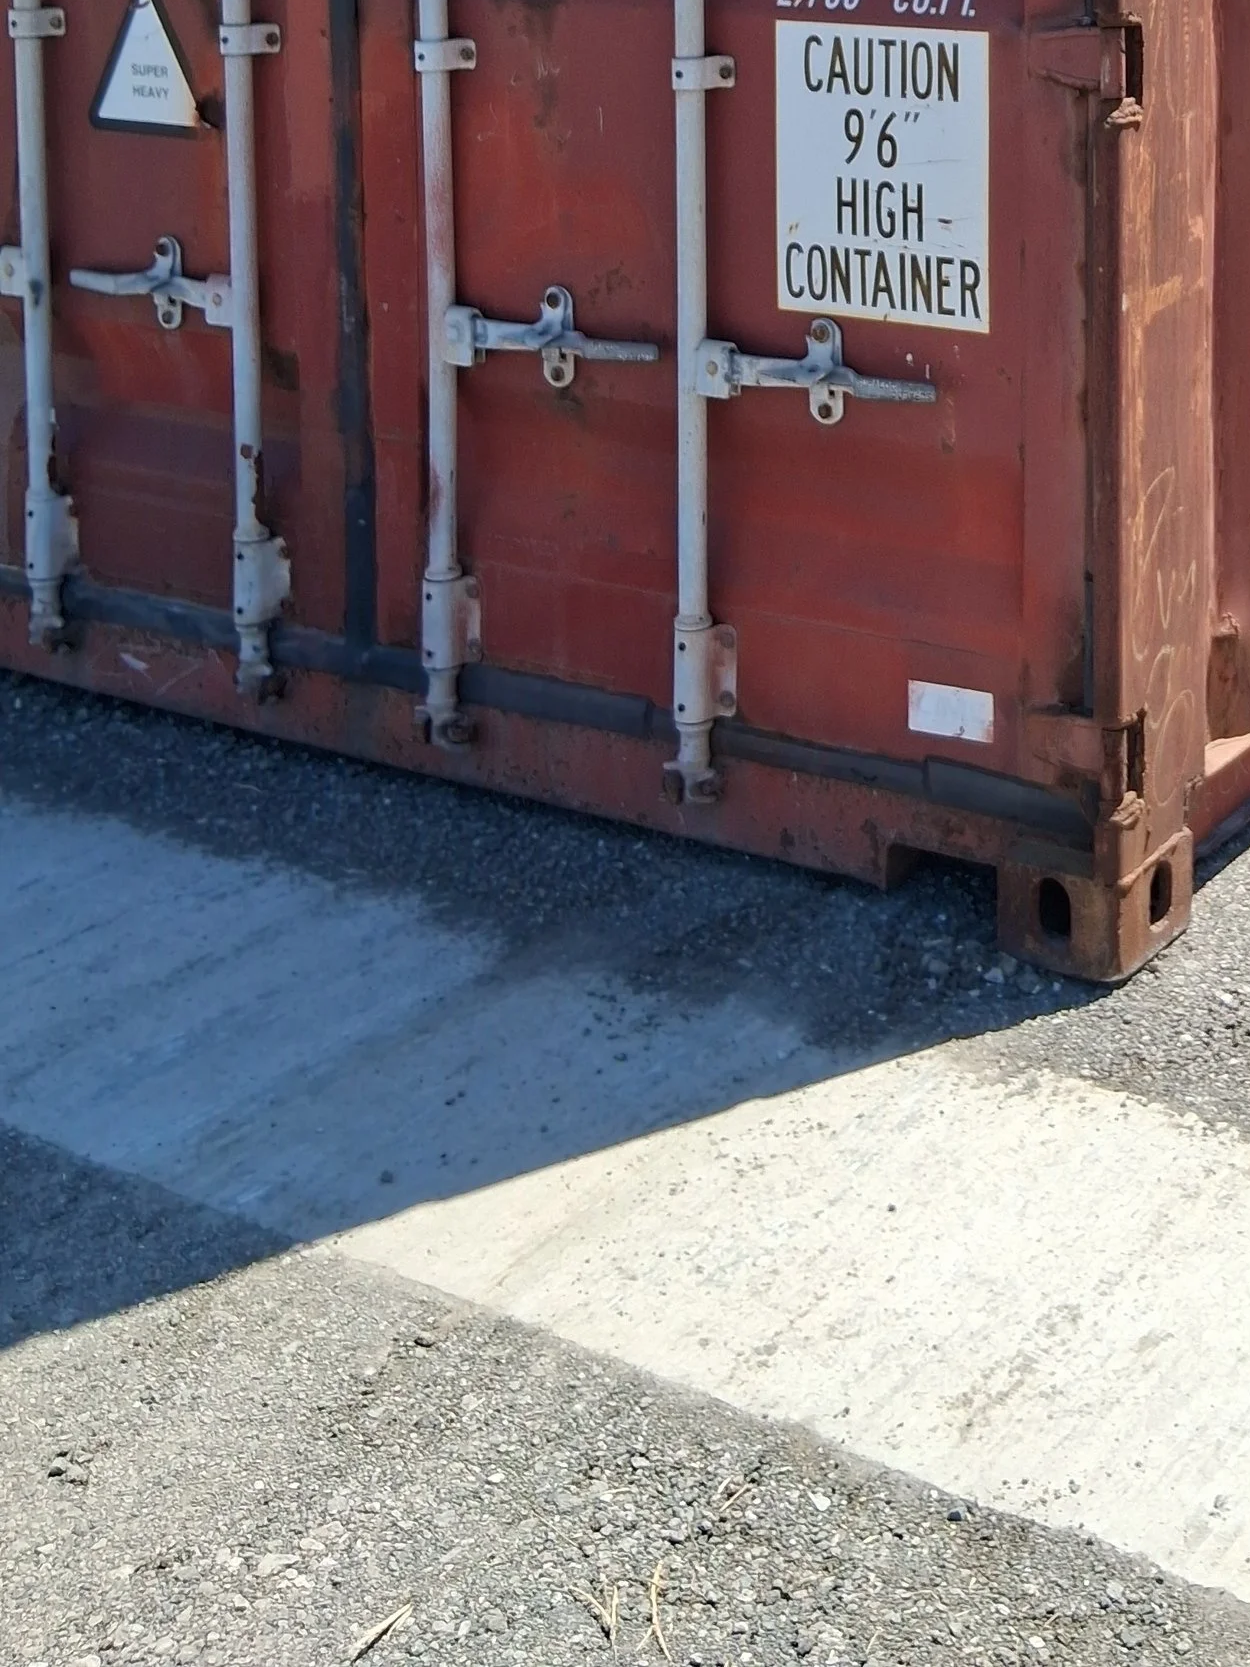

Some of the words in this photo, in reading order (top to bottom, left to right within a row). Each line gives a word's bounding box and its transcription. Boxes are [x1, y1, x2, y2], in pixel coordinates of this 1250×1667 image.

[131, 62, 169, 79] SUPER
[132, 84, 170, 101] HEAVY
[803, 35, 960, 103] CAUTION
[836, 176, 925, 242] HIGH
[784, 242, 982, 321] CONTAINER
